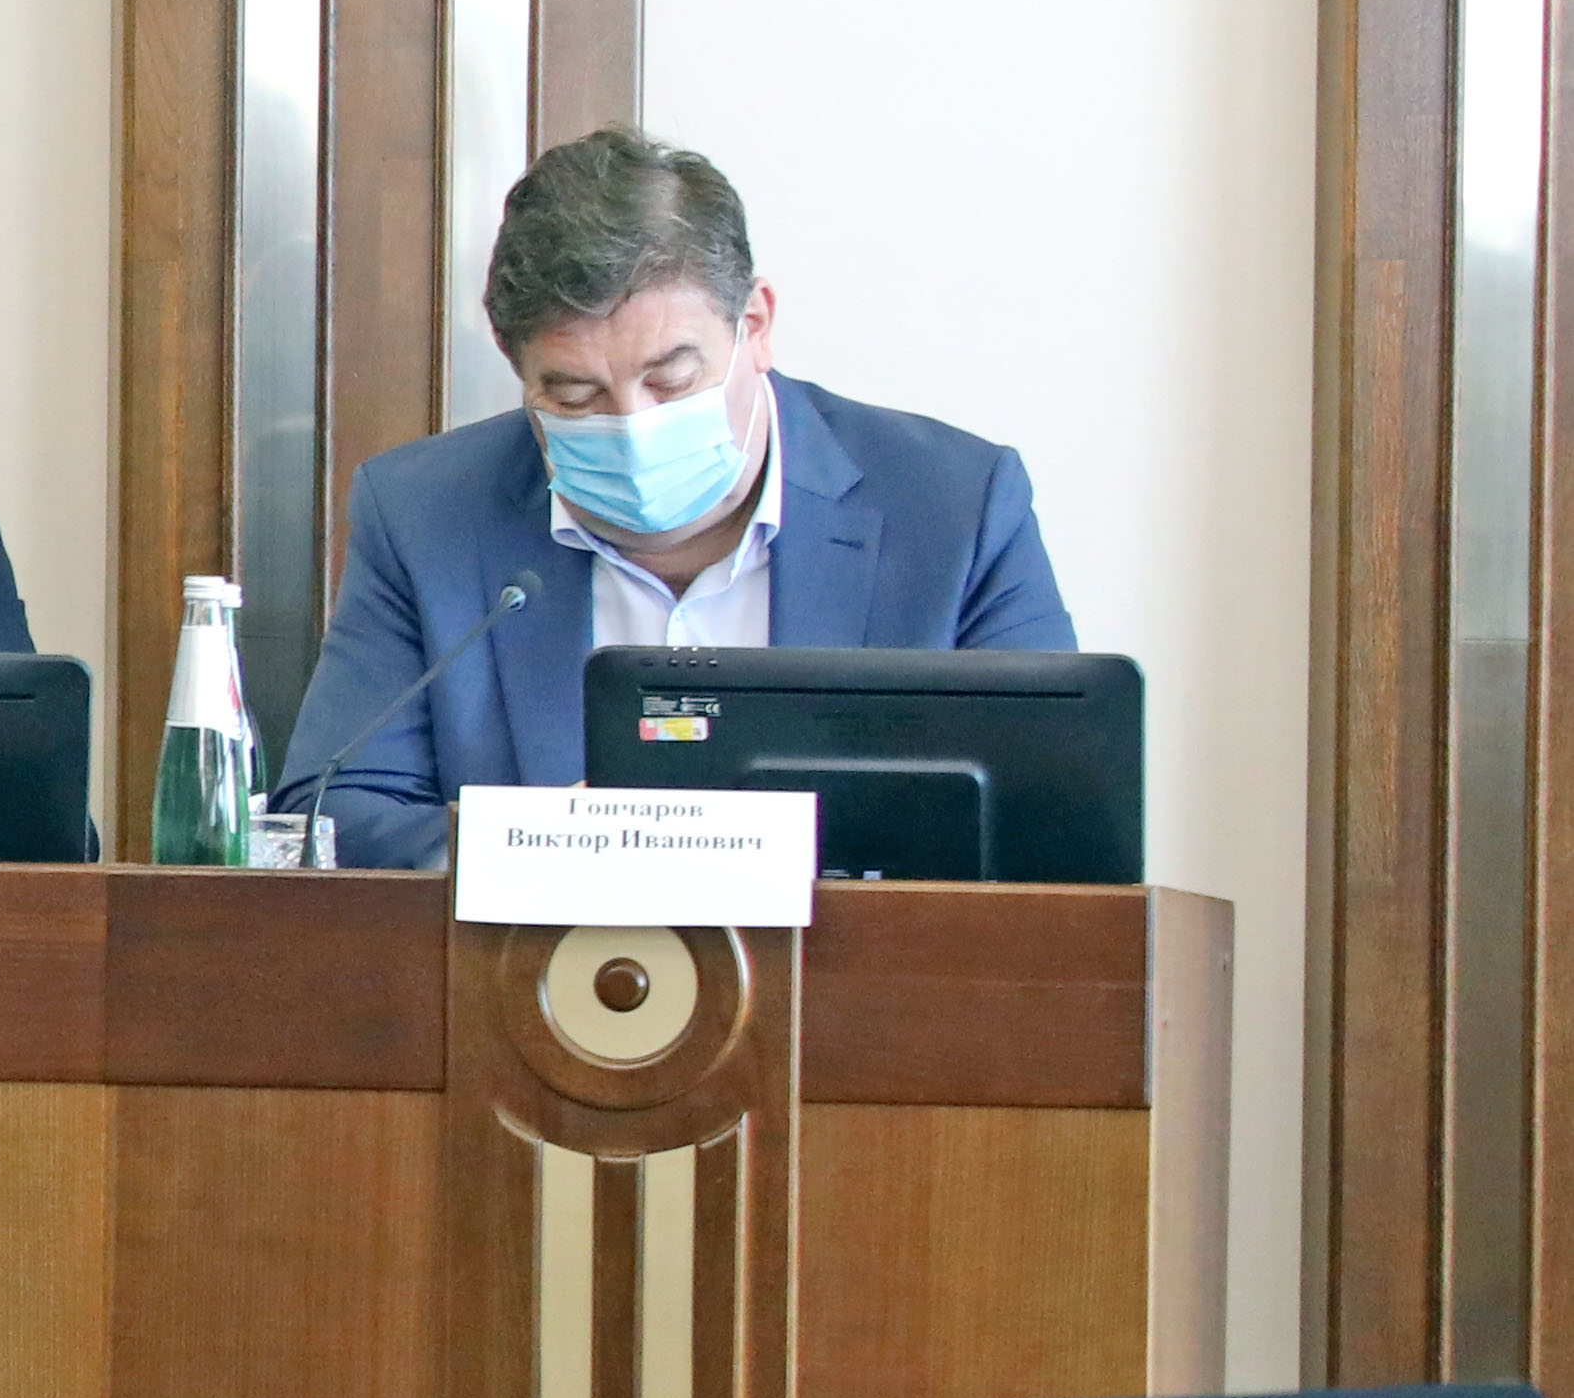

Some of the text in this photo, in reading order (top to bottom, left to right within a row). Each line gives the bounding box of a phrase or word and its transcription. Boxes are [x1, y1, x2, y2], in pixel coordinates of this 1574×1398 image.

[569, 797, 703, 822] Гончаров
[507, 827, 762, 854] Виктор Иванович
